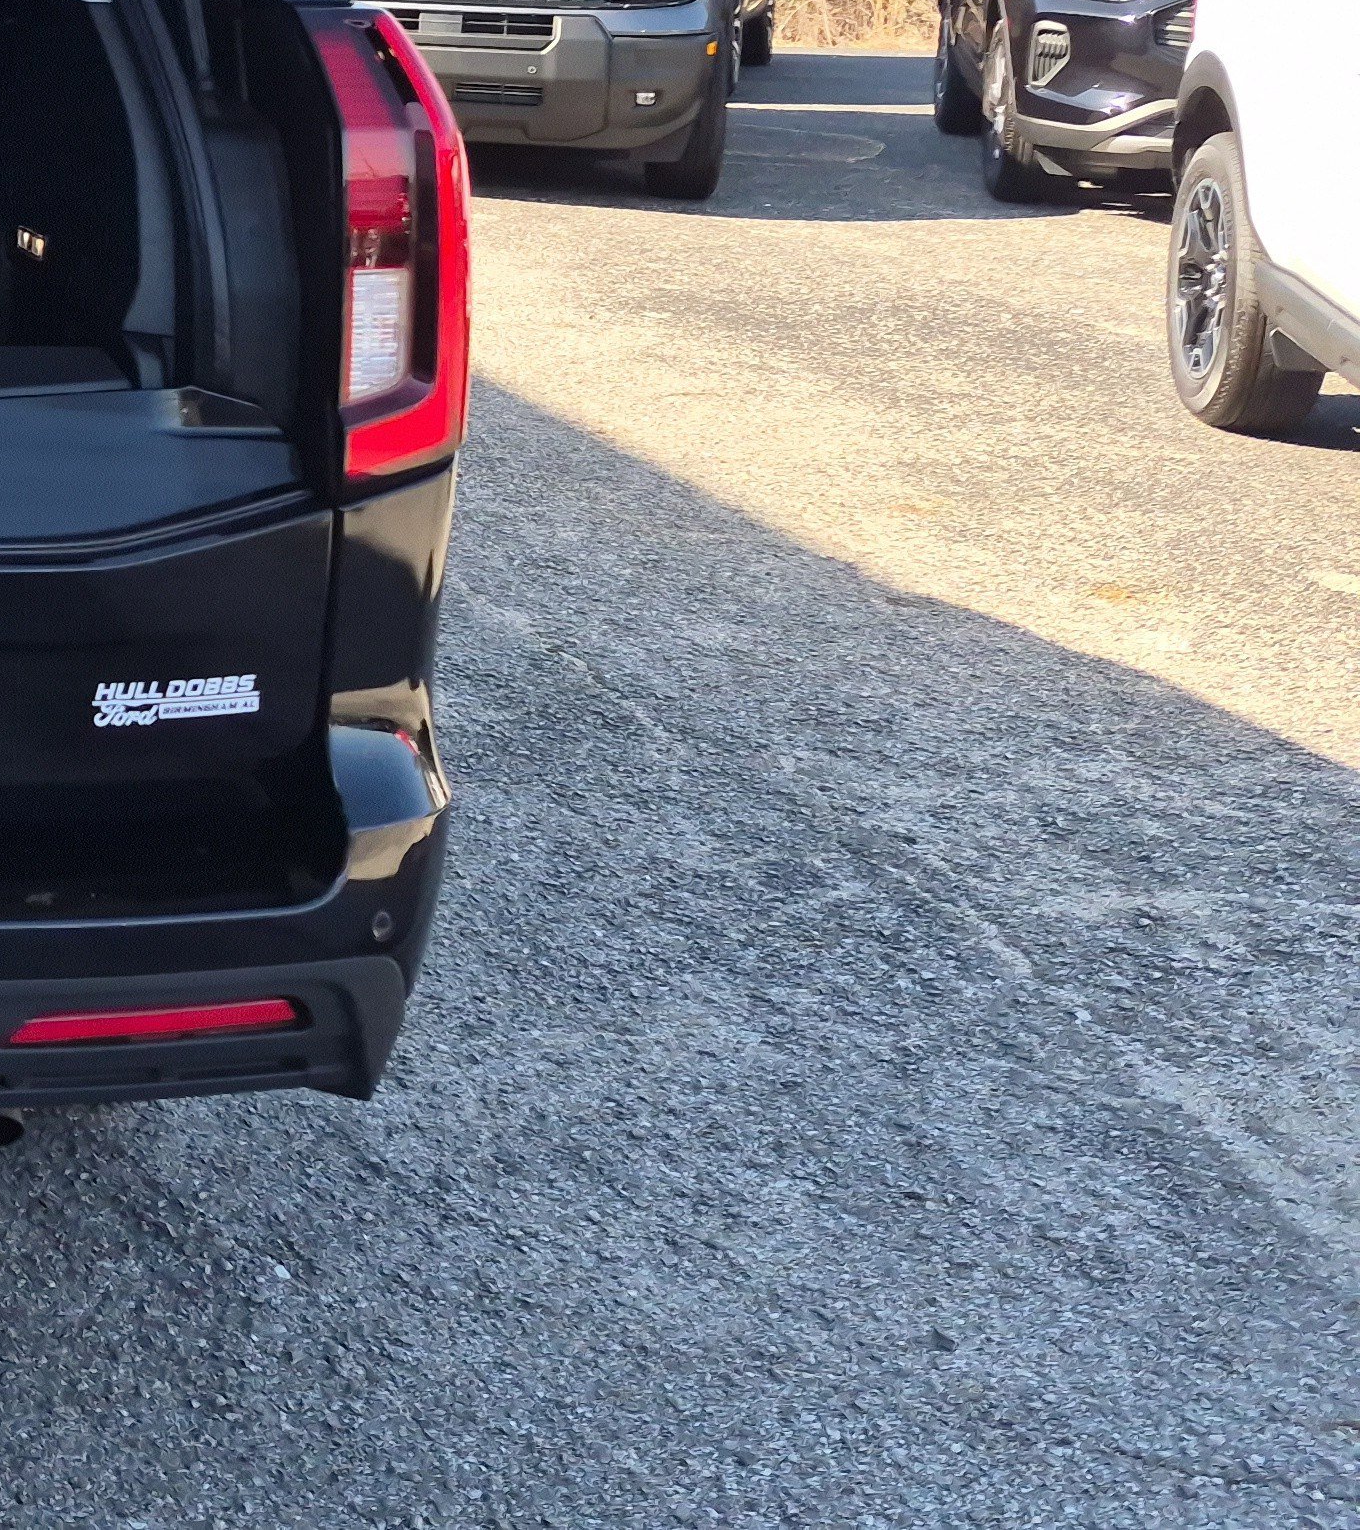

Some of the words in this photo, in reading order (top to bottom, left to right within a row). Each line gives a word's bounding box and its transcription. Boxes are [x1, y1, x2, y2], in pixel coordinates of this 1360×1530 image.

[95, 681, 163, 701] HULL
[165, 674, 258, 698] DOBBS
[93, 703, 159, 728] Ford
